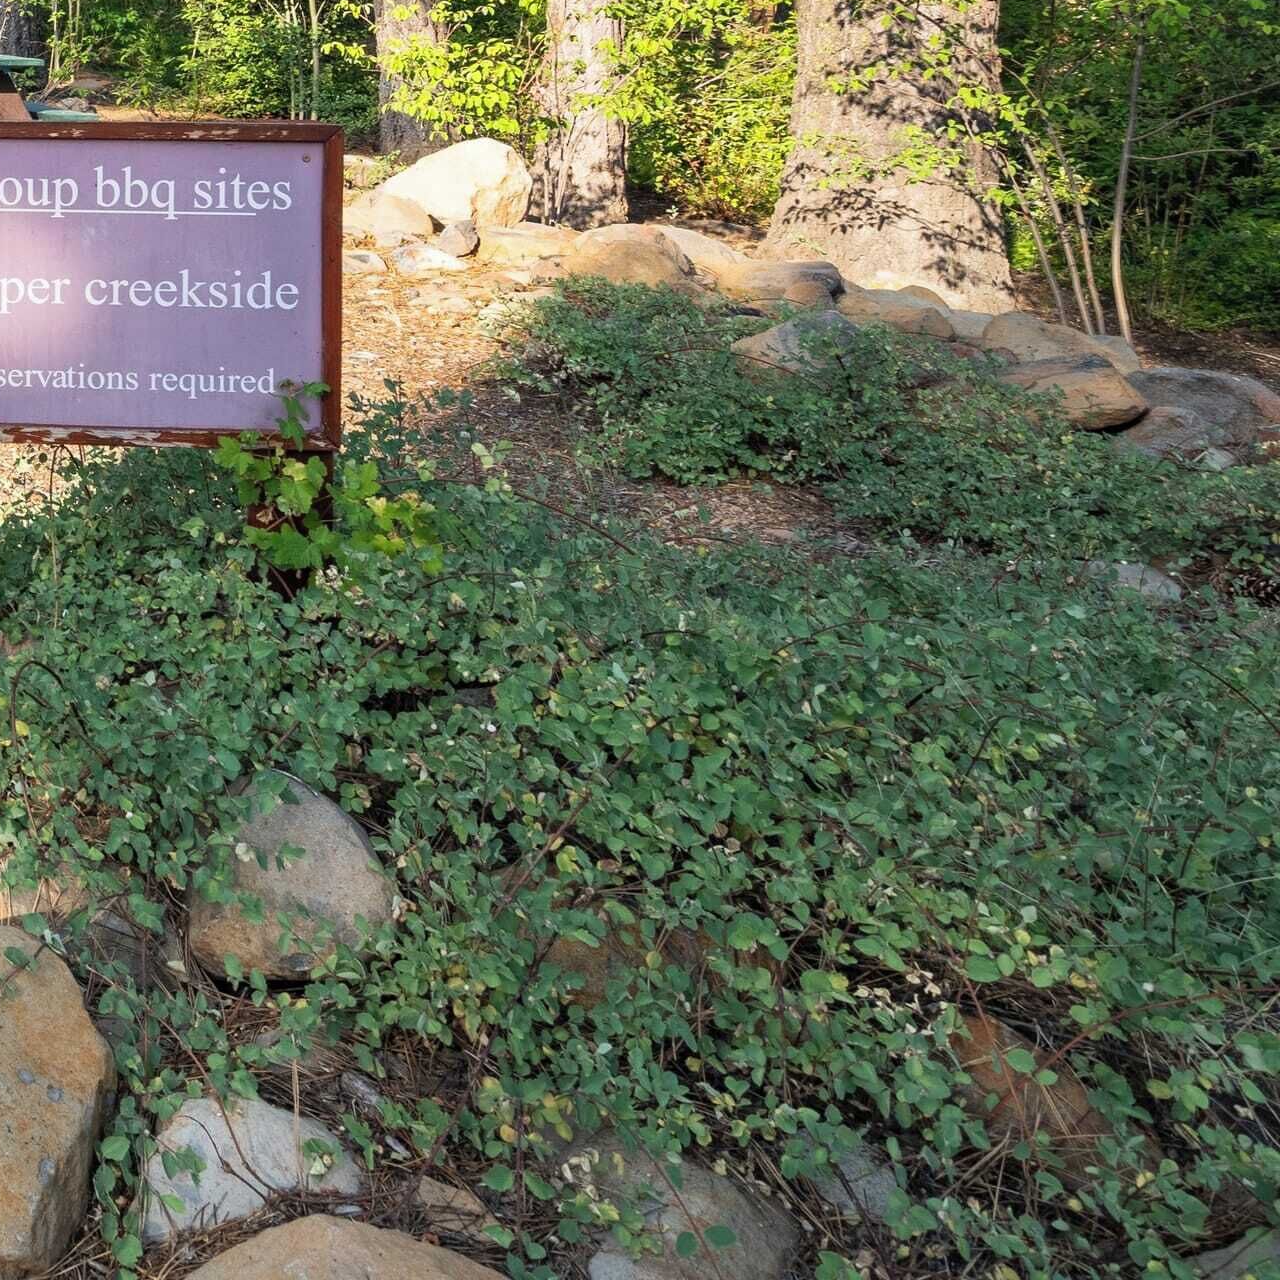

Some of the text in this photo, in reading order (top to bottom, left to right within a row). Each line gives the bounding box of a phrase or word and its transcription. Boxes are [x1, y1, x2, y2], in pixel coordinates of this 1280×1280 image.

[94, 166, 178, 220] bbq
[193, 167, 292, 210] sites
[85, 269, 299, 310] creekside
[148, 367, 276, 399] required
